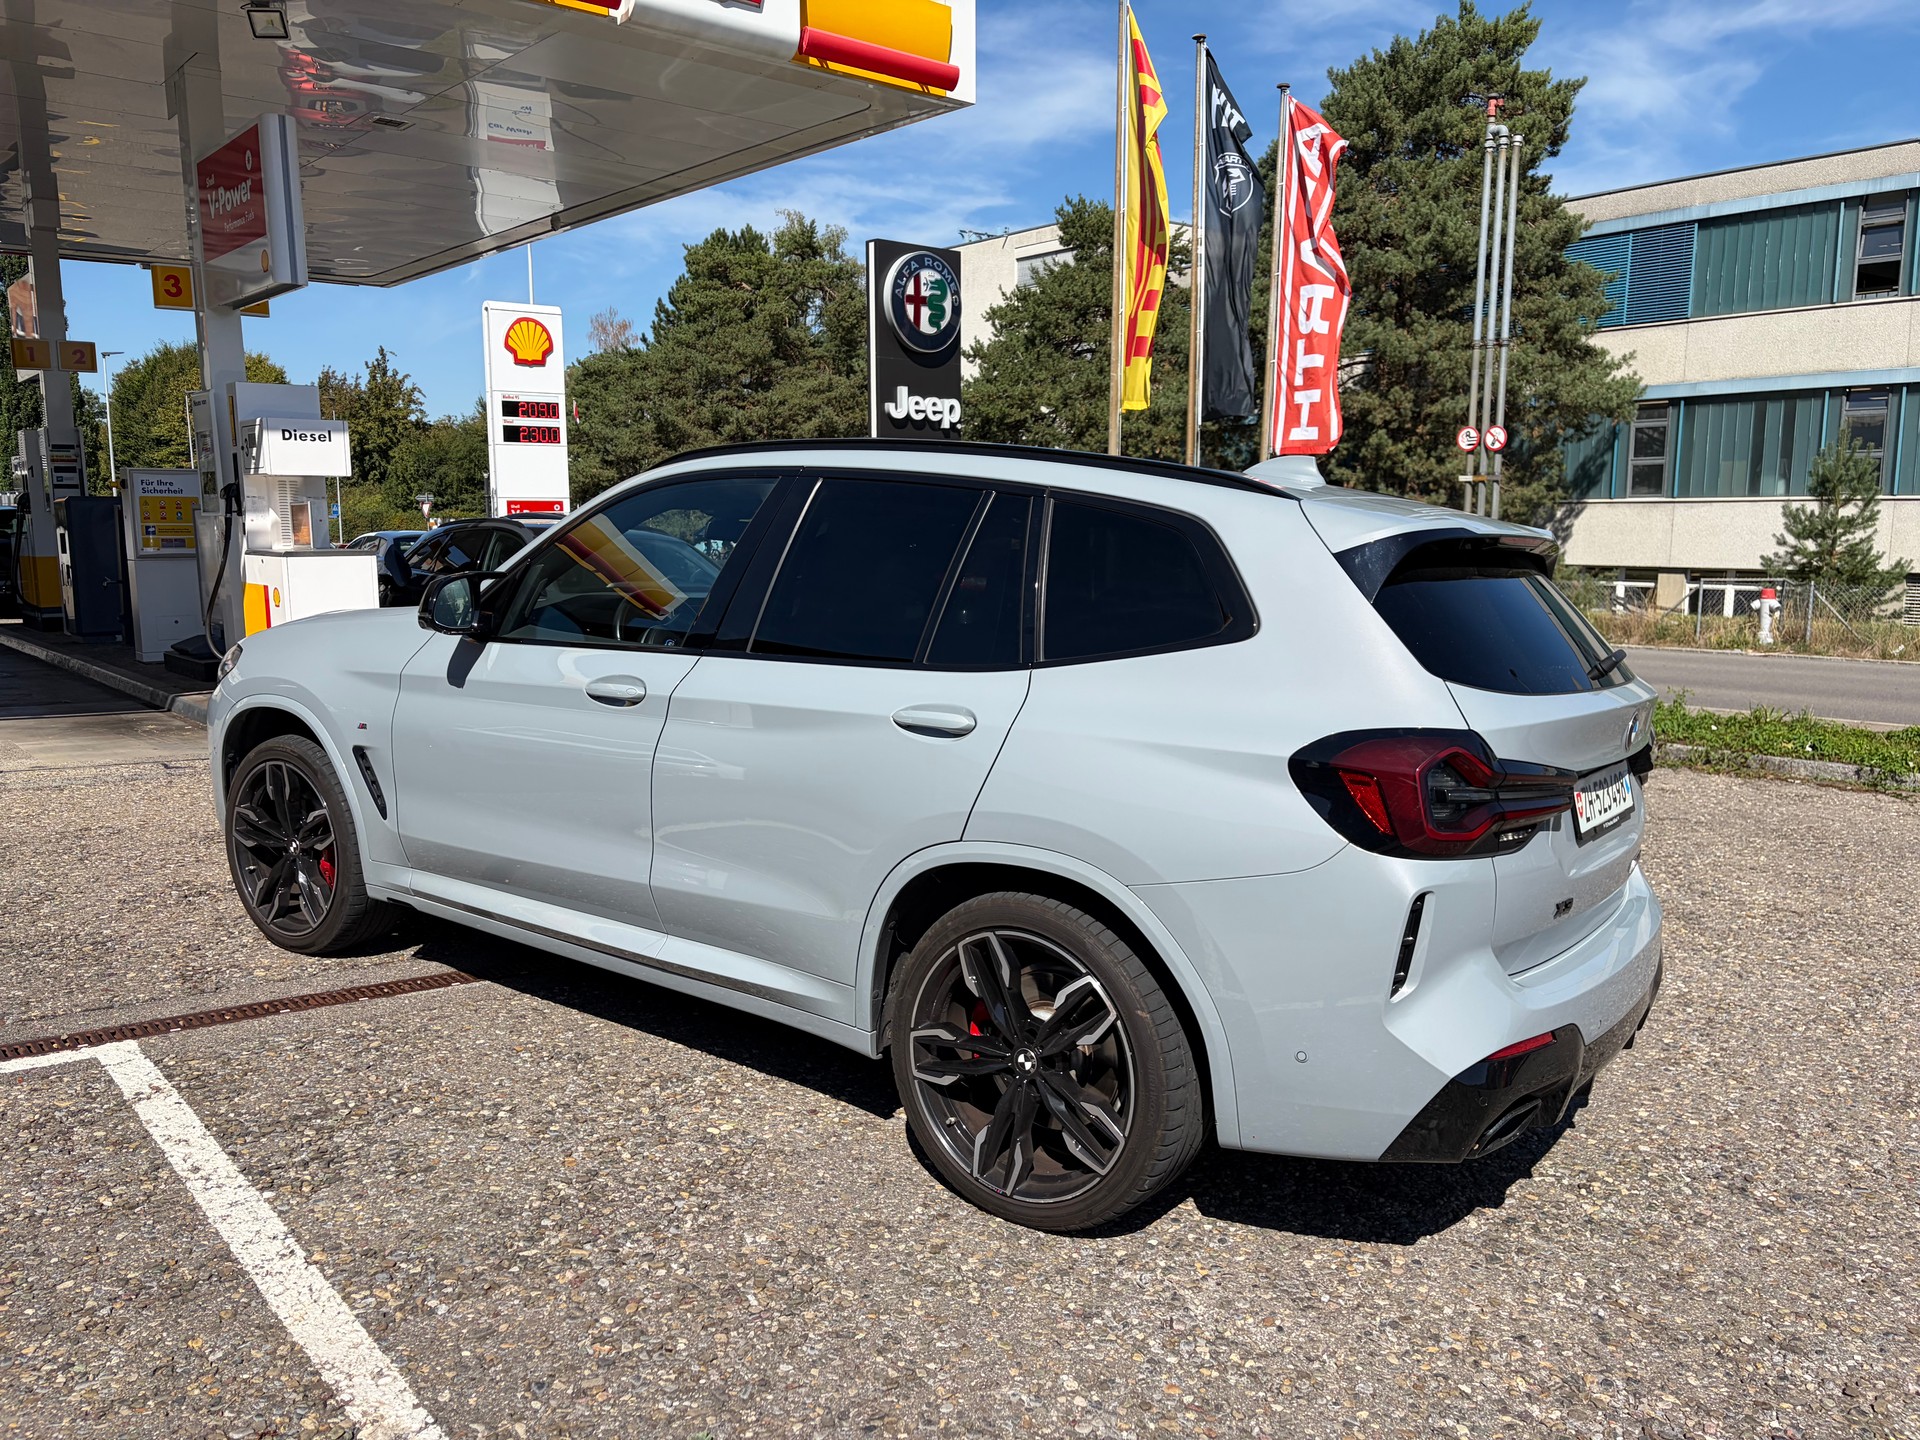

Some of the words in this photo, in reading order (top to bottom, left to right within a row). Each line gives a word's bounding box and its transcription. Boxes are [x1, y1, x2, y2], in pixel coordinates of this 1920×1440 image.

[206, 174, 215, 188] Shell
[207, 178, 252, 219] V-Power
[245, 207, 255, 222] Fuels
[163, 274, 183, 298] 3
[895, 262, 920, 299] ALFA
[924, 257, 960, 307] ROMEO
[26, 346, 36, 362] 1
[71, 348, 87, 365] 2
[518, 401, 559, 419] 209.0
[884, 386, 961, 429] Jeep
[281, 428, 332, 443] Diesel
[519, 426, 560, 443] 230.0
[140, 479, 155, 487] Für
[157, 479, 174, 487] Ihre
[141, 487, 184, 495] Sicherheit
